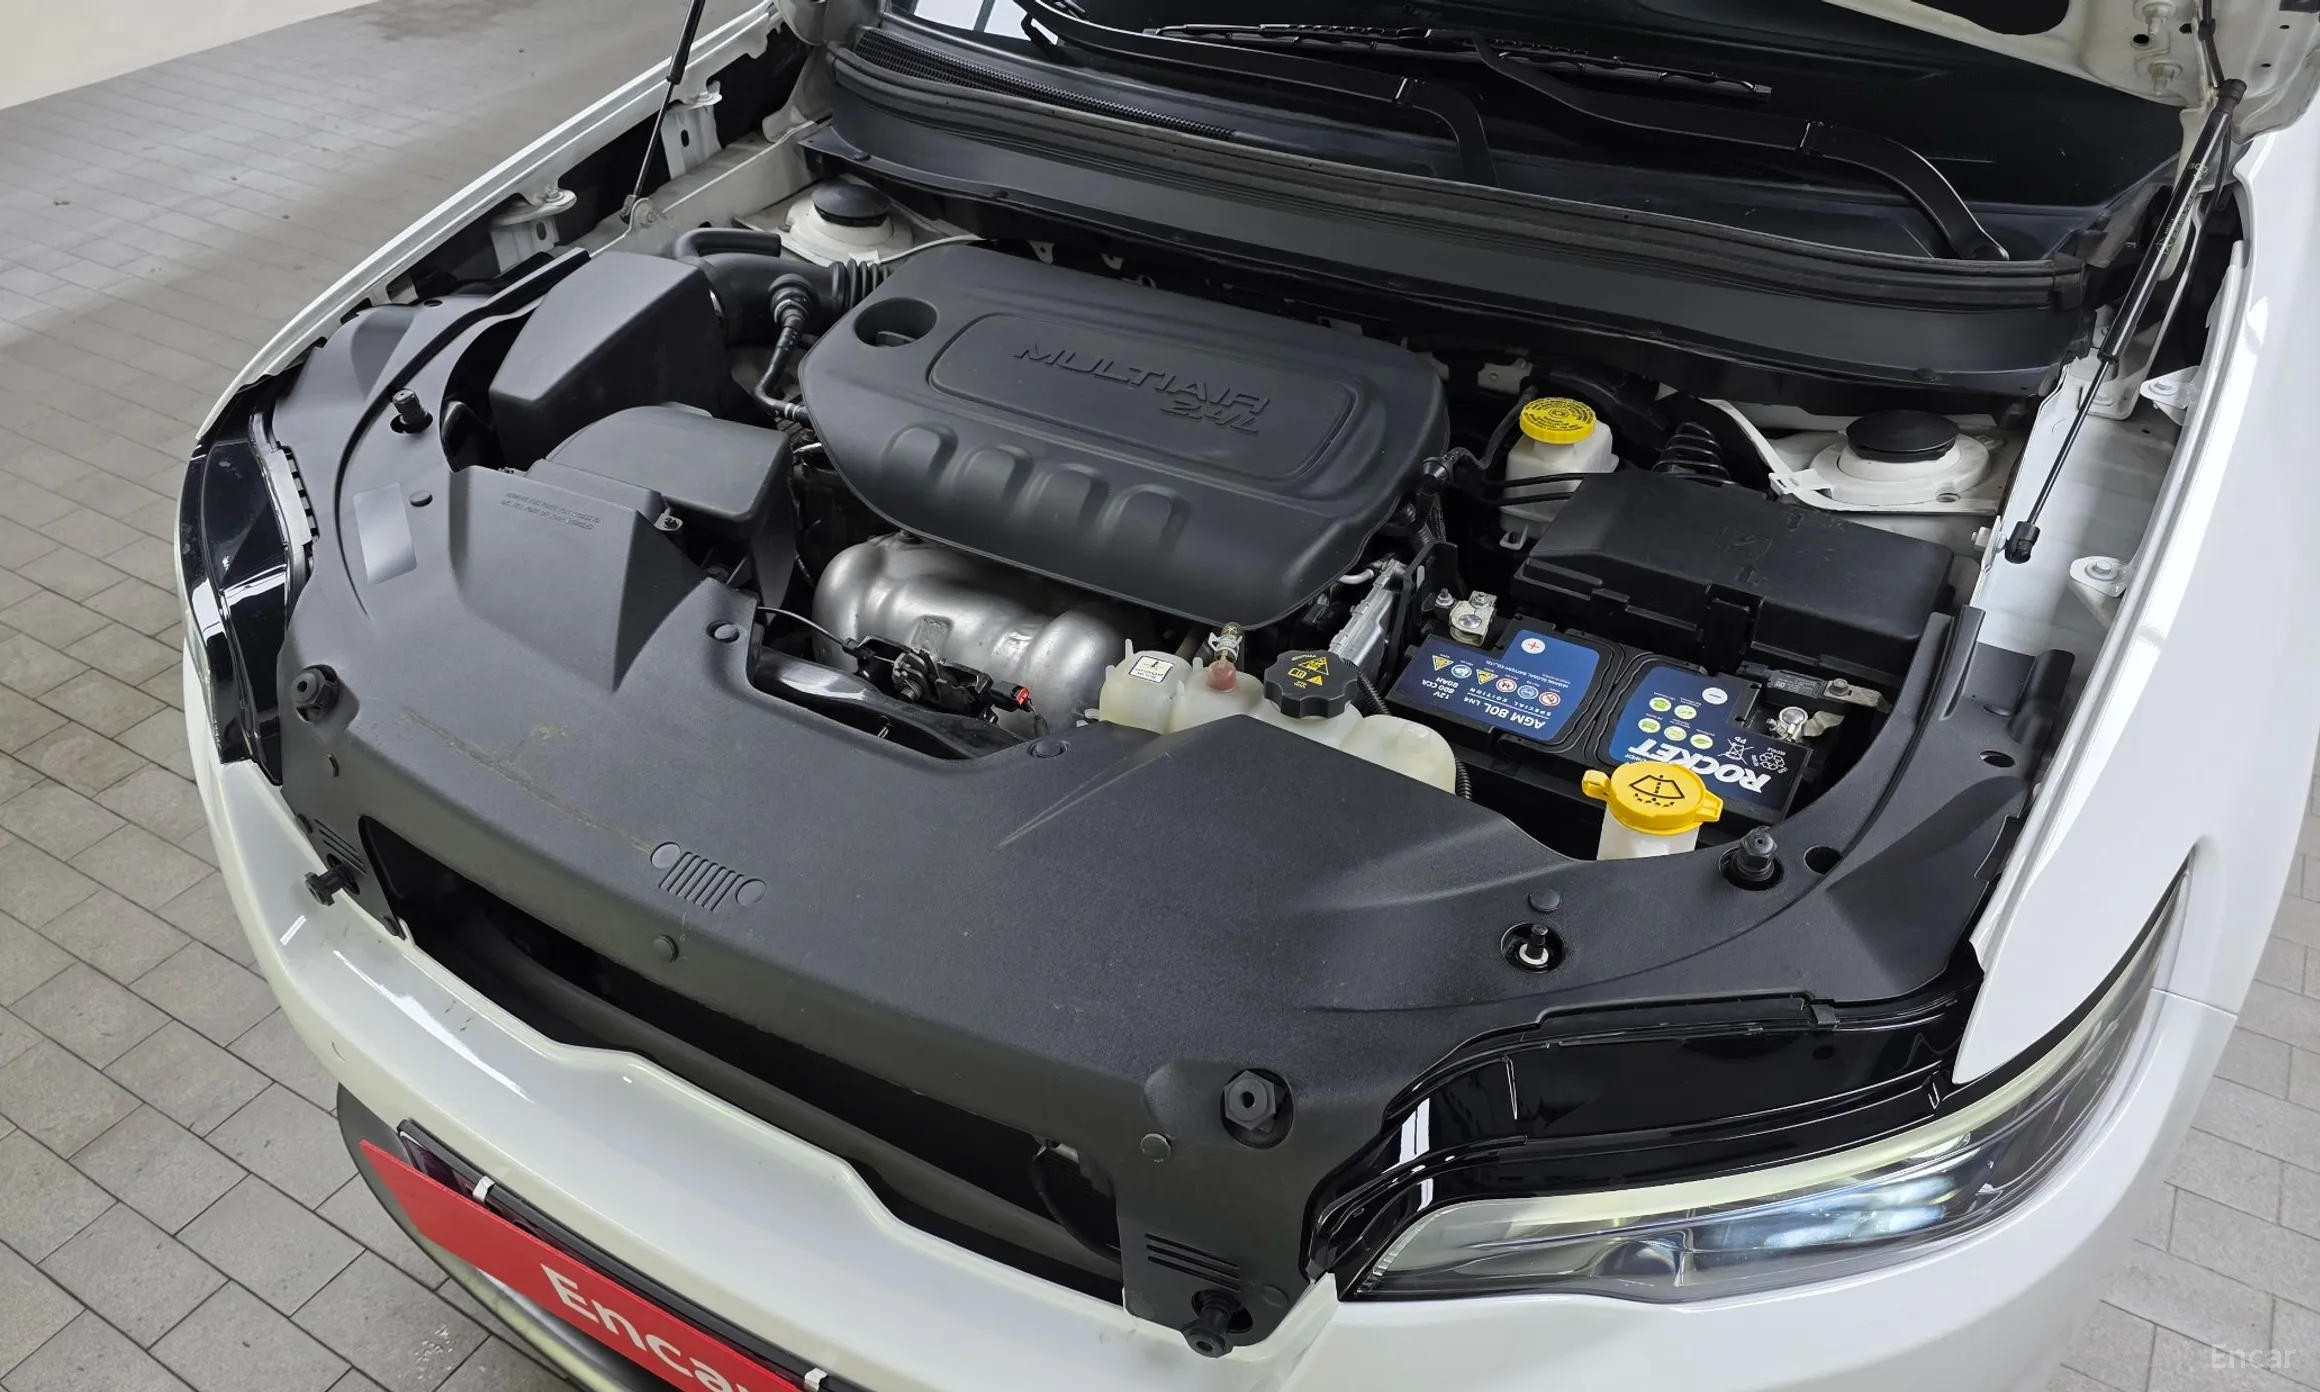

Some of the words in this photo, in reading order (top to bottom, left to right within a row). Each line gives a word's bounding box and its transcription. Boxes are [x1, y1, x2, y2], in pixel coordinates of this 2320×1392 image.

[1013, 343, 1271, 415] MULTIAIR
[1484, 702, 1510, 718] 80L
[1511, 712, 1547, 730] AGM
[1627, 738, 1772, 794] ROCKET
[540, 1263, 750, 1392] Enca
